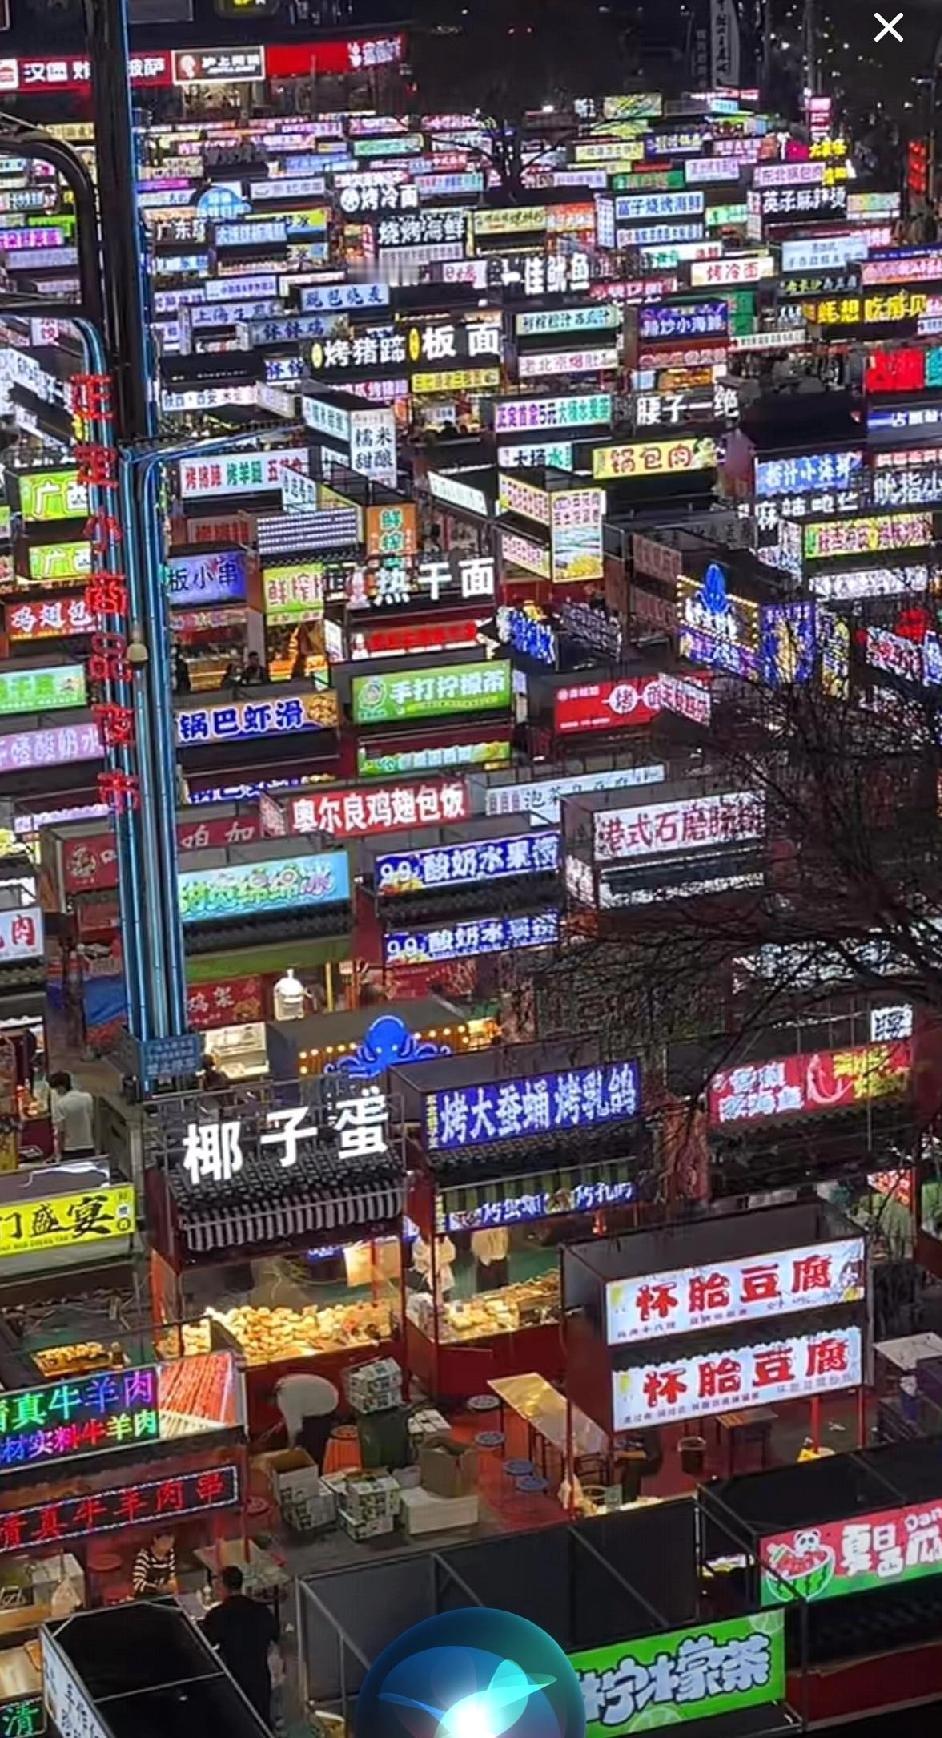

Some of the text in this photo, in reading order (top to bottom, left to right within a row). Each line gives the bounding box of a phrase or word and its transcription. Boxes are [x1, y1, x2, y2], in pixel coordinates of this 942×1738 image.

[361, 184, 418, 210] 烤冷面
[380, 216, 465, 244] 烧烤海鲜
[707, 261, 758, 281] 烤冷面
[324, 336, 406, 368] 烤猪蹄
[423, 324, 502, 361] 板面
[636, 382, 739, 427] 腰子一绝
[611, 445, 692, 474] 锅包肉
[375, 557, 494, 607] 热干面
[11, 600, 93, 633] 鸡翅包
[390, 671, 505, 705] 手打柠檬茶
[179, 699, 304, 742] 锅巴虾滑
[293, 783, 465, 835] 奥尔良鸡翅包饭
[440, 1064, 638, 1146] 烤大蚕蛹 烤乳鸽
[182, 1086, 390, 1185] 椰子蛋
[636, 1256, 833, 1322] 怀胎豆腐
[642, 1338, 851, 1408] 怀胎豆腐
[1, 1472, 226, 1546] 清真牛羊肉串
[576, 1633, 771, 1725] 柠檬茶
[2, 1705, 39, 1737] 清
